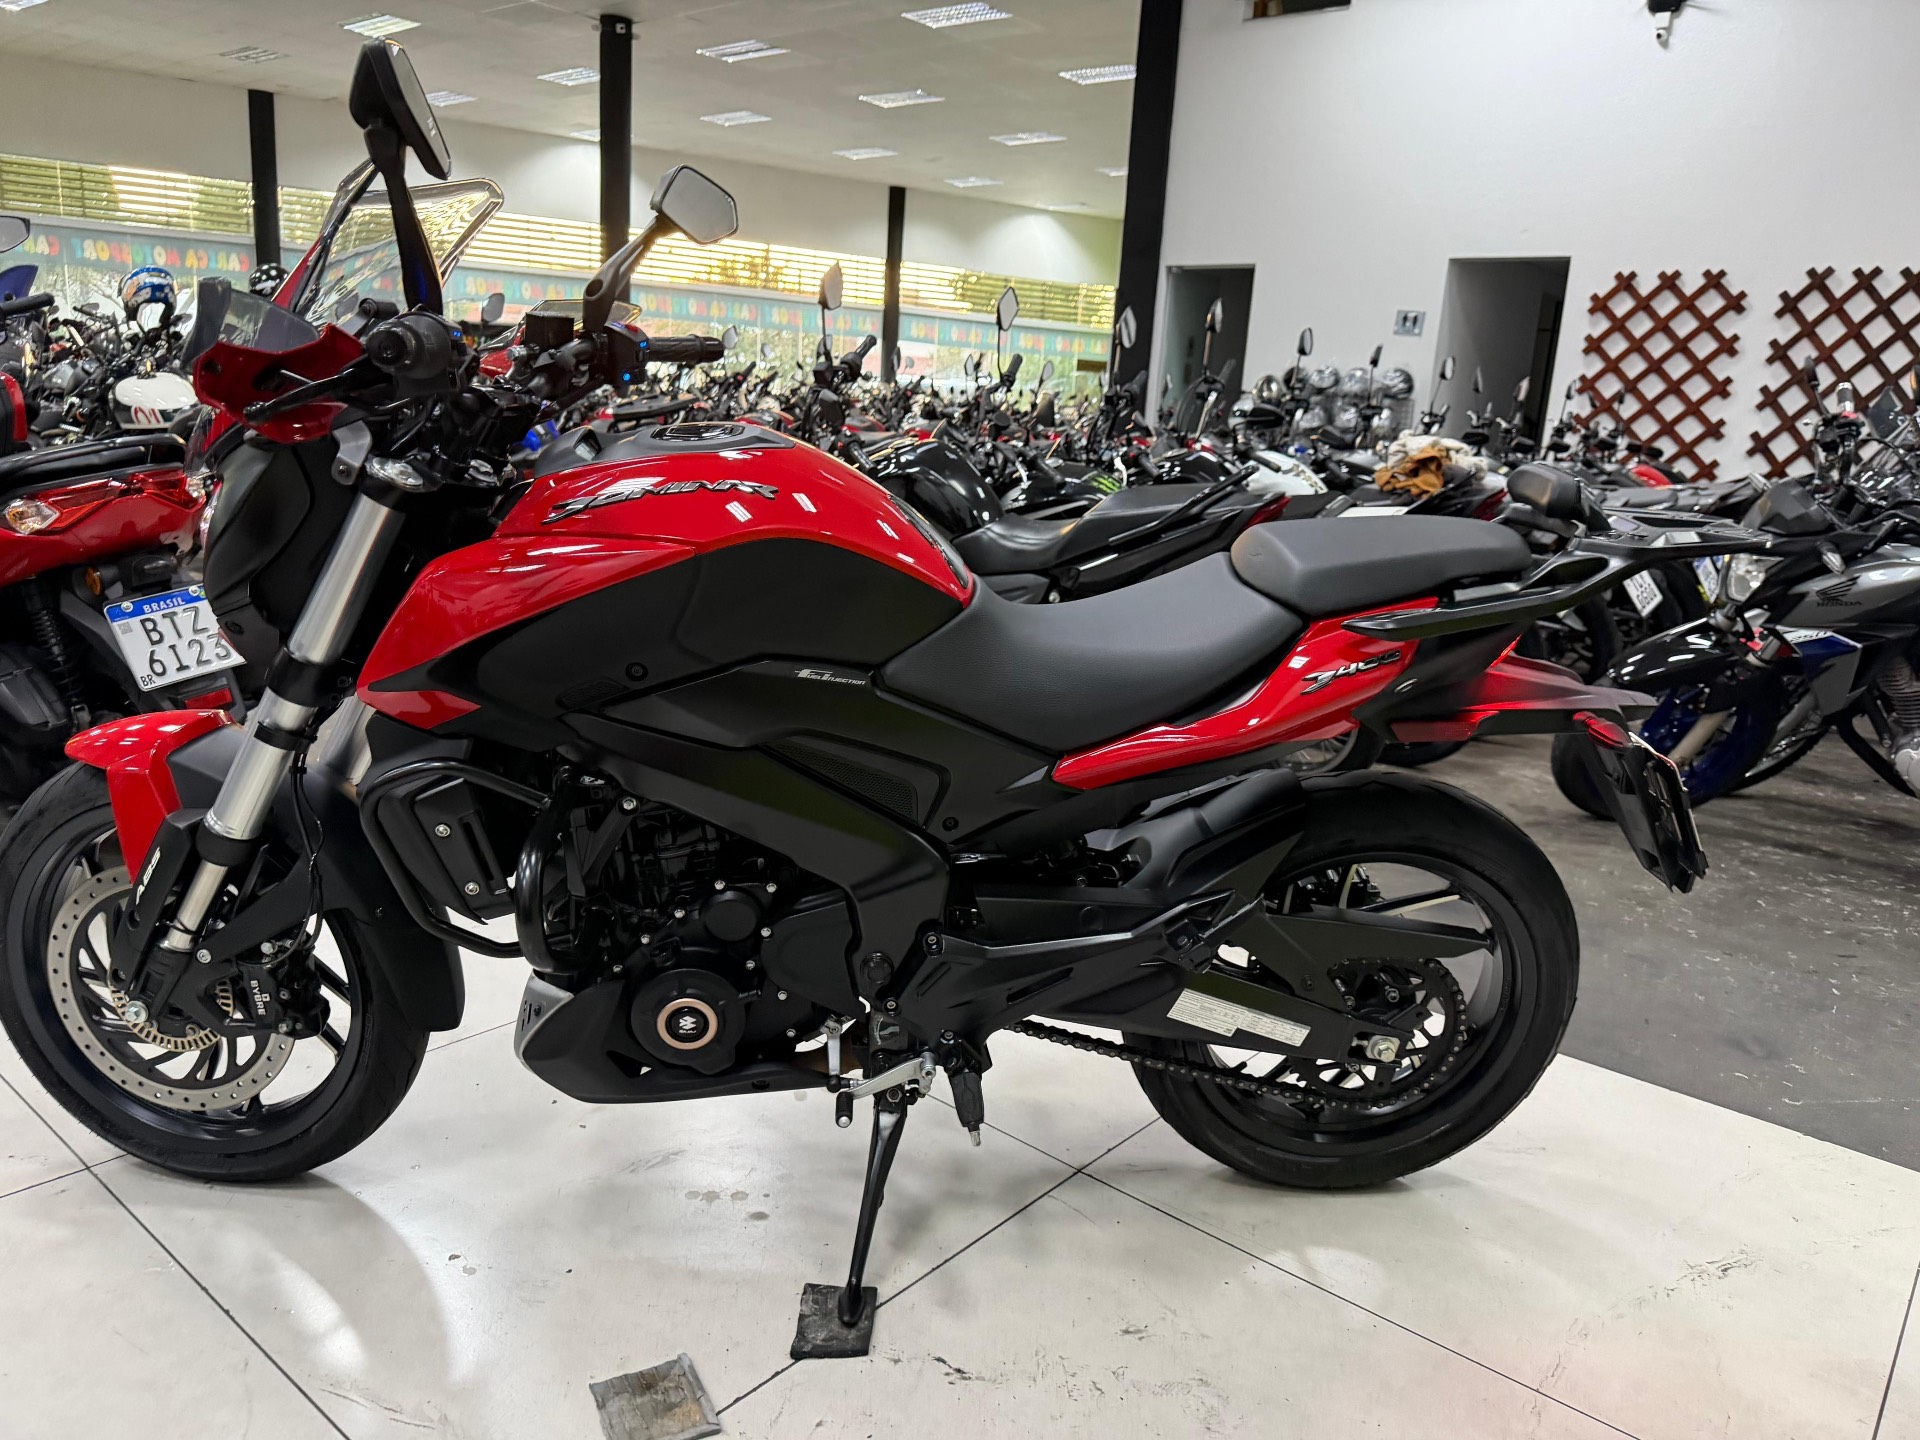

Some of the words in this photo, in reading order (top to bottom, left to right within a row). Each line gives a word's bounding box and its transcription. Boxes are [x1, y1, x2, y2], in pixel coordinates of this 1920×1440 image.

[142, 596, 187, 614] BRASIL
[139, 605, 209, 646] BTZ
[140, 674, 156, 687] BR
[250, 979, 267, 1016] BYBRE
